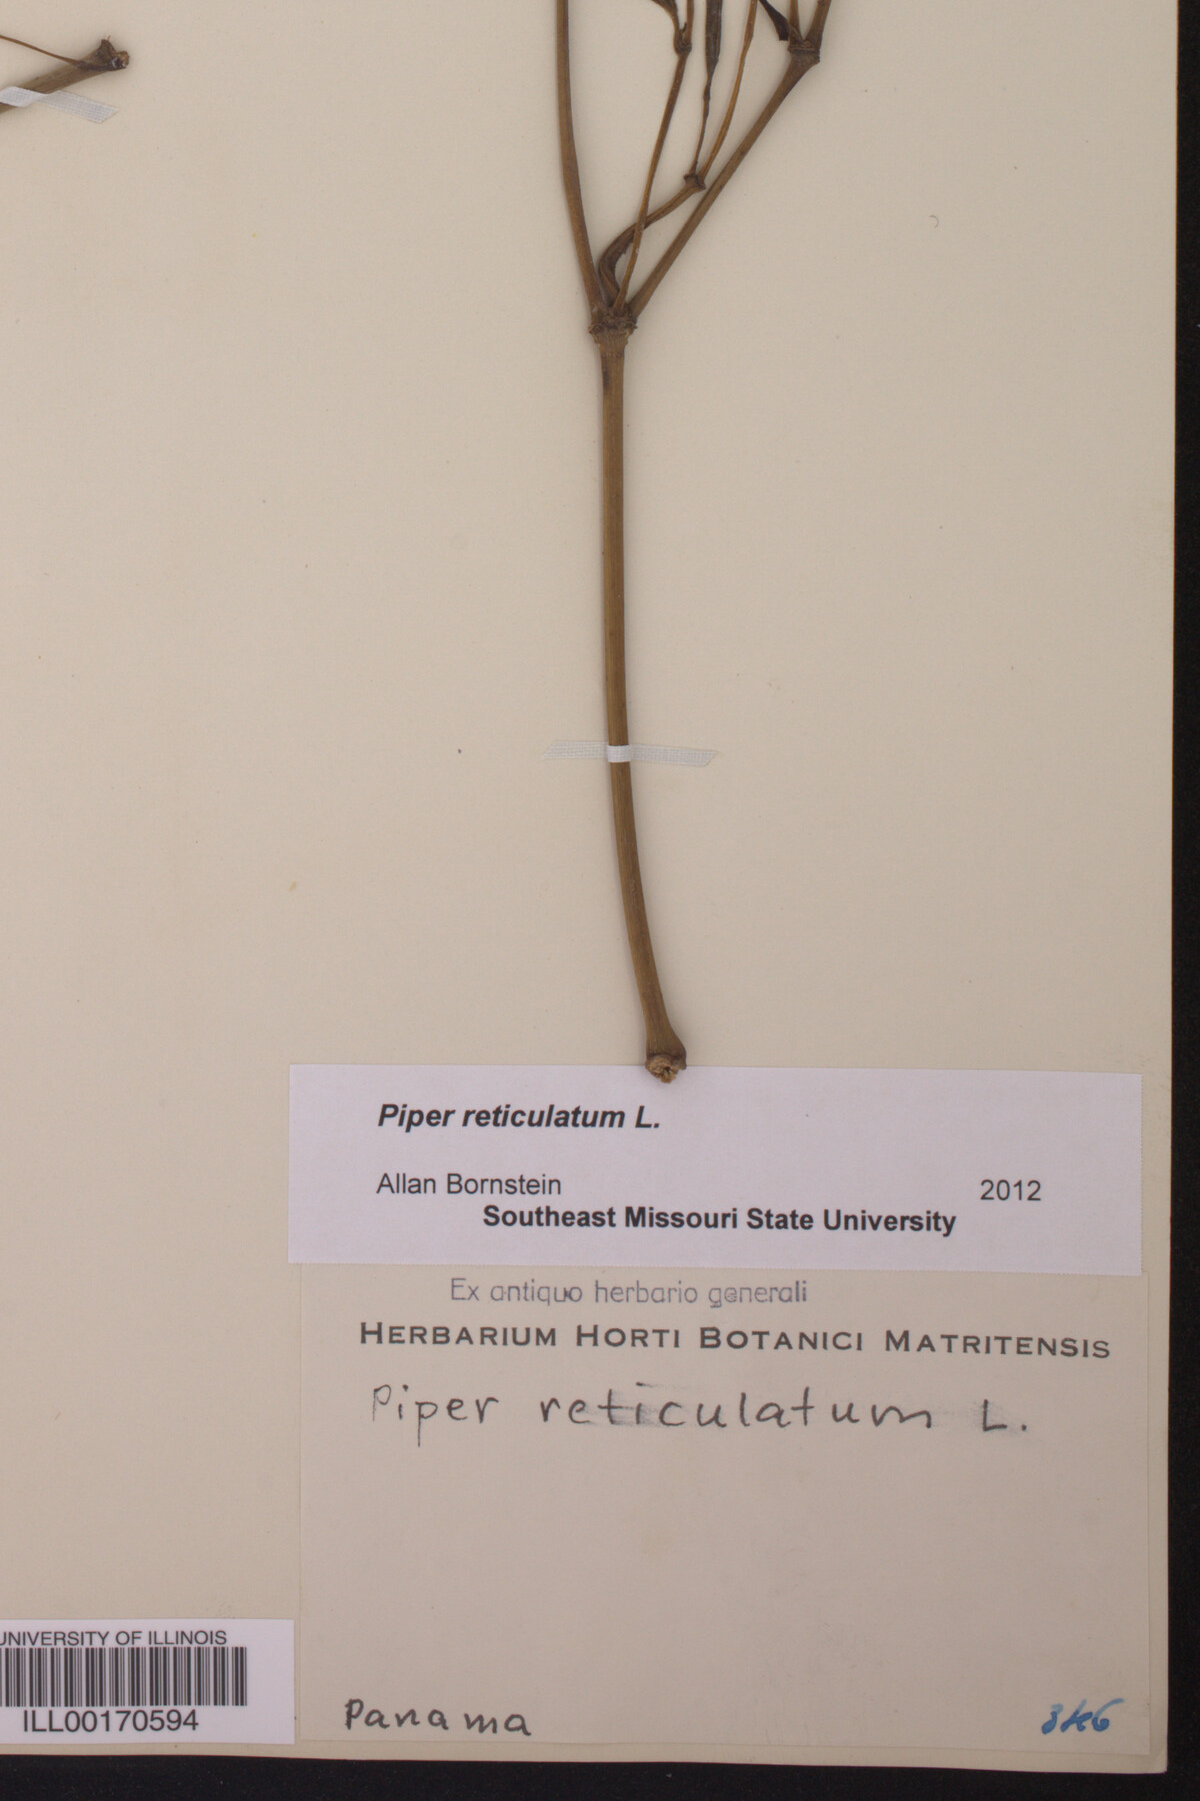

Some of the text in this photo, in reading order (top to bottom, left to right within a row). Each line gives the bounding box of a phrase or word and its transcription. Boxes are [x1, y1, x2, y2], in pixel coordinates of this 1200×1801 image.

[377, 1105, 661, 1131] Piper reticulatum L.
[376, 1173, 1042, 1201] Allan Bornstein 2012
[482, 1206, 957, 1236] Southeast Missouri State University
[450, 1278, 808, 1308] Ex antiquo herbario generali
[360, 1321, 1112, 1359] HERBARIUM HORTI BOTANICI MATRITENSIS
[373, 1382, 1028, 1448] Piper reticulatum L.
[115, 1631, 143, 1646] OF
[149, 1631, 228, 1646] ILLINOIS
[23, 1710, 199, 1732] ILL00170594
[344, 1699, 533, 1736] Panama
